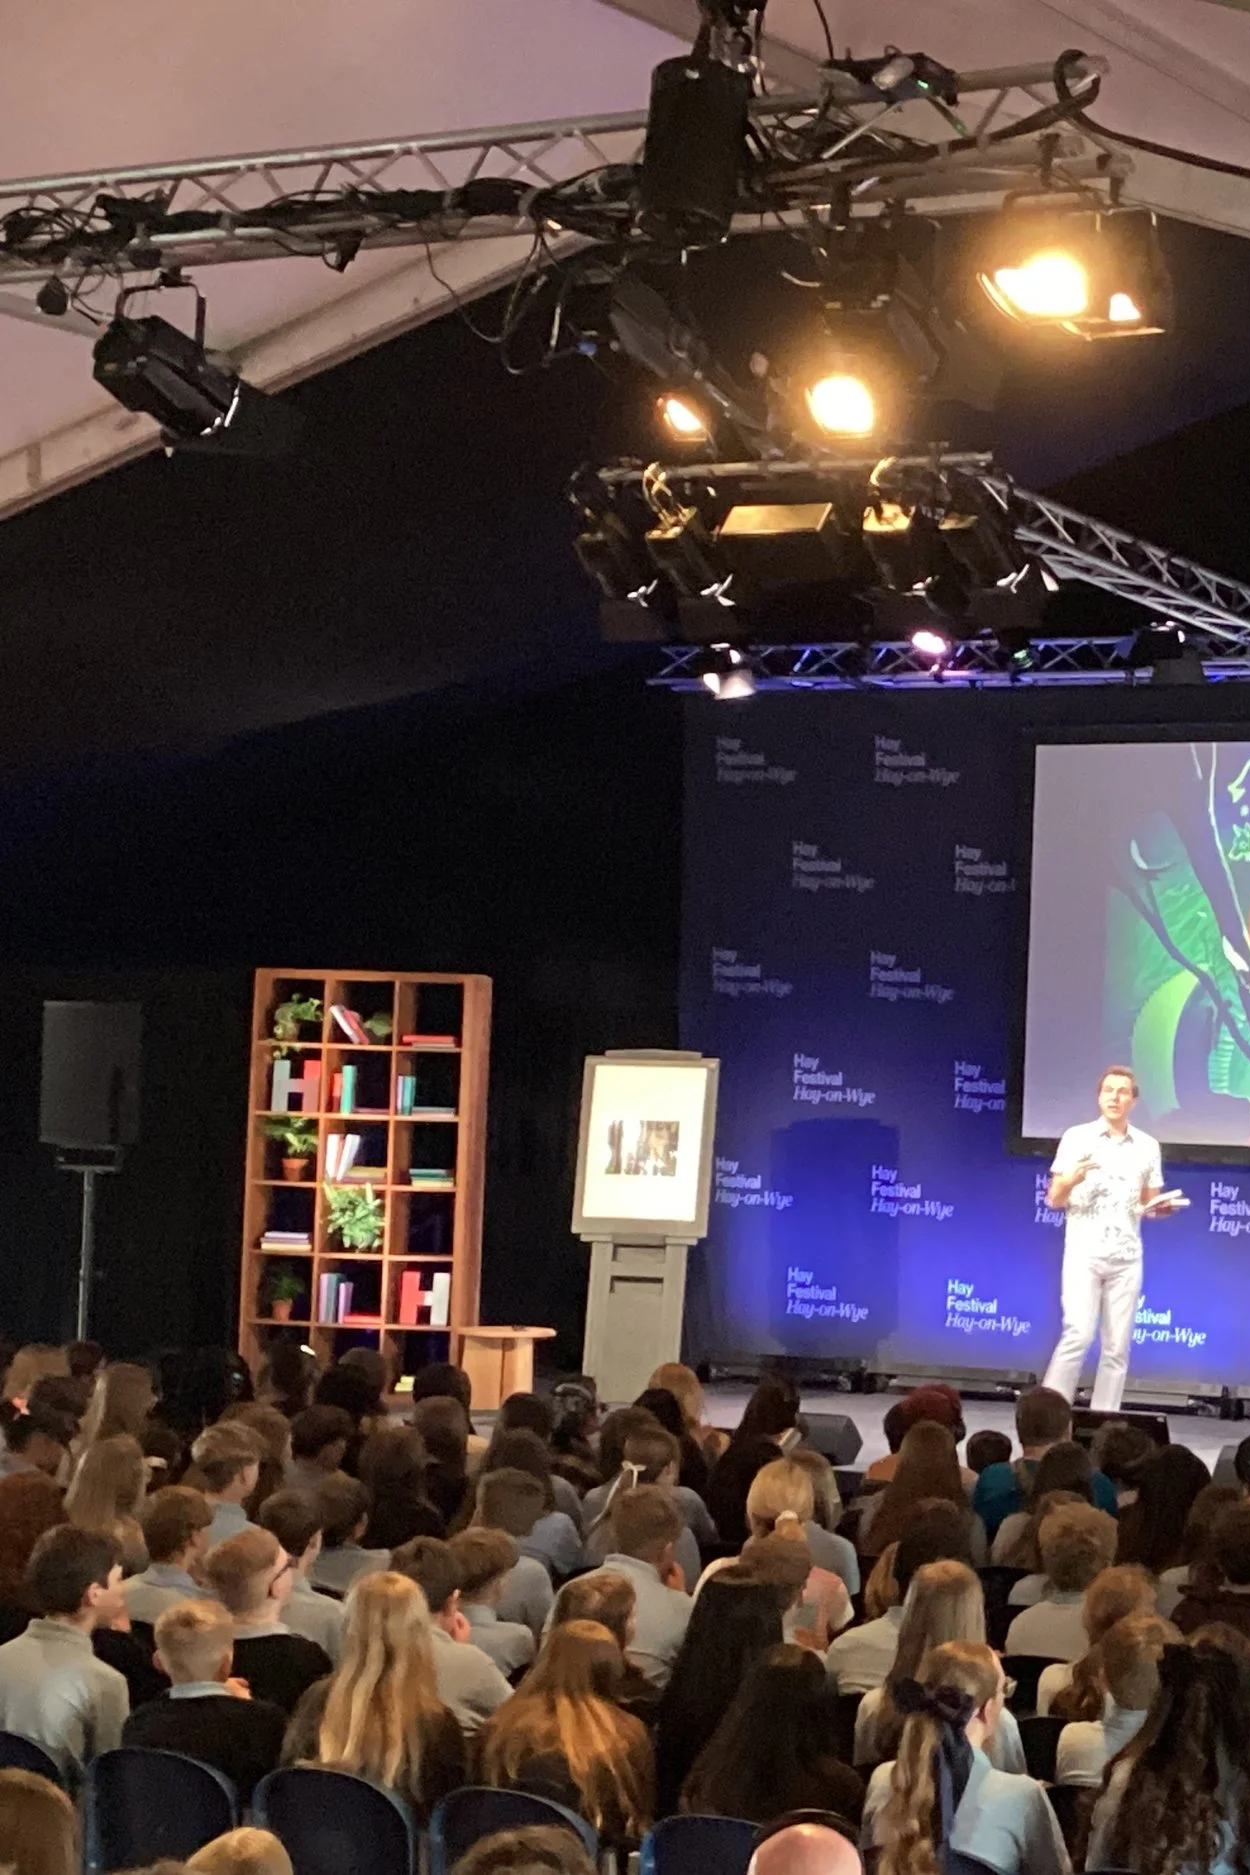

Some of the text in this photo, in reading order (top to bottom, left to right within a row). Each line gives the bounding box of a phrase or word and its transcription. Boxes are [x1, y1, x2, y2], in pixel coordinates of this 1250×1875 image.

[794, 1053, 820, 1072] Hay
[794, 1070, 842, 1086] Festival
[794, 1086, 876, 1108] Hay-on-Wye
[716, 1157, 738, 1174] Hay
[871, 1165, 898, 1182] Hay
[716, 1173, 761, 1190] Festival
[871, 1182, 922, 1199] Festival
[1210, 1182, 1239, 1200] Hay
[870, 1198, 954, 1220] Hay-on-Wye
[787, 1267, 814, 1286] Hay
[787, 1284, 837, 1301] Festival
[948, 1279, 974, 1298] Hay
[786, 1300, 869, 1323] Hay-on-Wye
[946, 1296, 998, 1315] Festival
[946, 1313, 1032, 1336] Hay-on-Wye
[1134, 1308, 1172, 1326] stival
